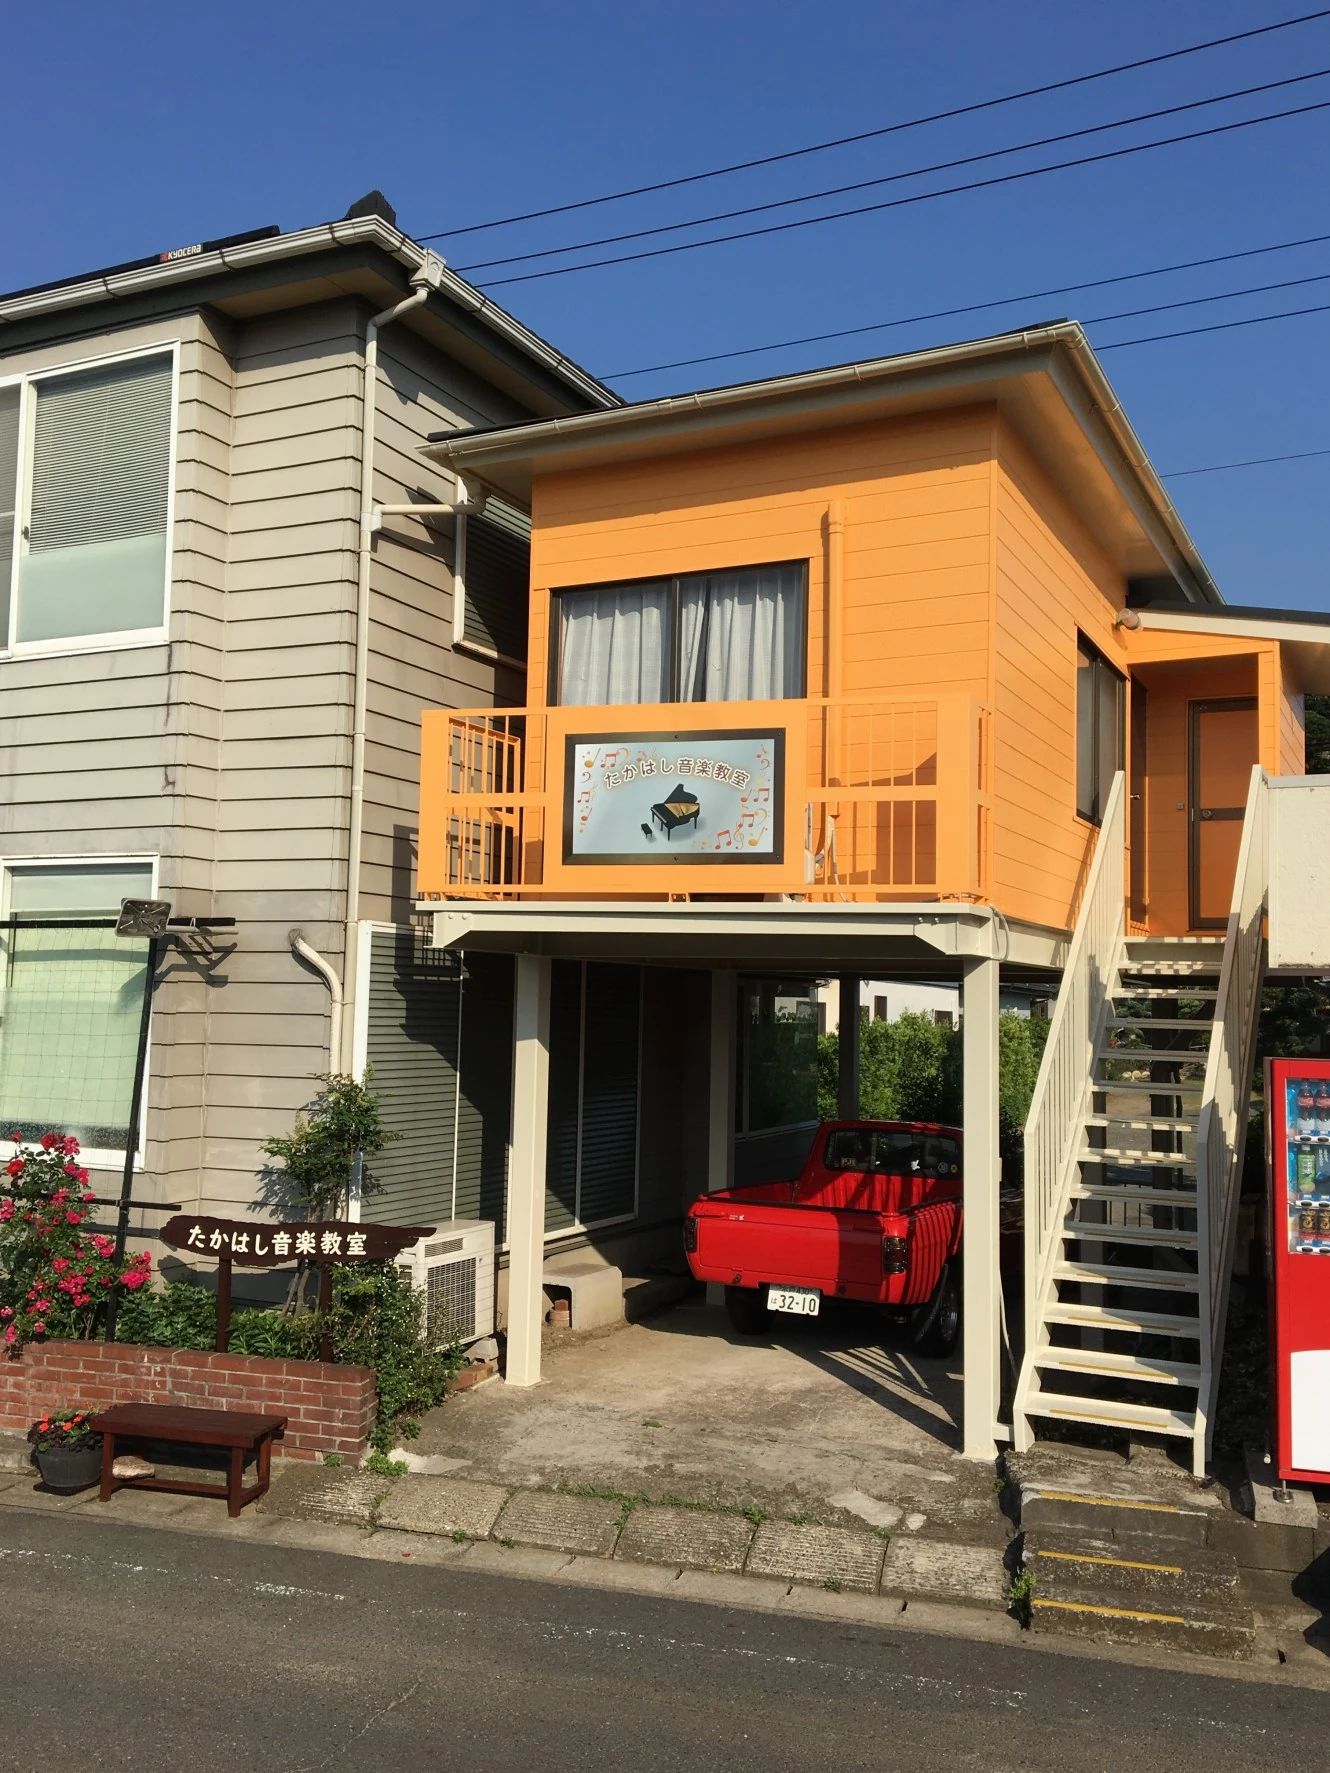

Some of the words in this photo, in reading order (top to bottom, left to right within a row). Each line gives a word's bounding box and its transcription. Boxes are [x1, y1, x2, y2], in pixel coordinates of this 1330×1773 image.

[167, 244, 202, 260] KYOCERA
[604, 757, 750, 789] たかはし音楽教室
[187, 1225, 367, 1256] たかはし音楽教室
[779, 1294, 816, 1312] 32-10
